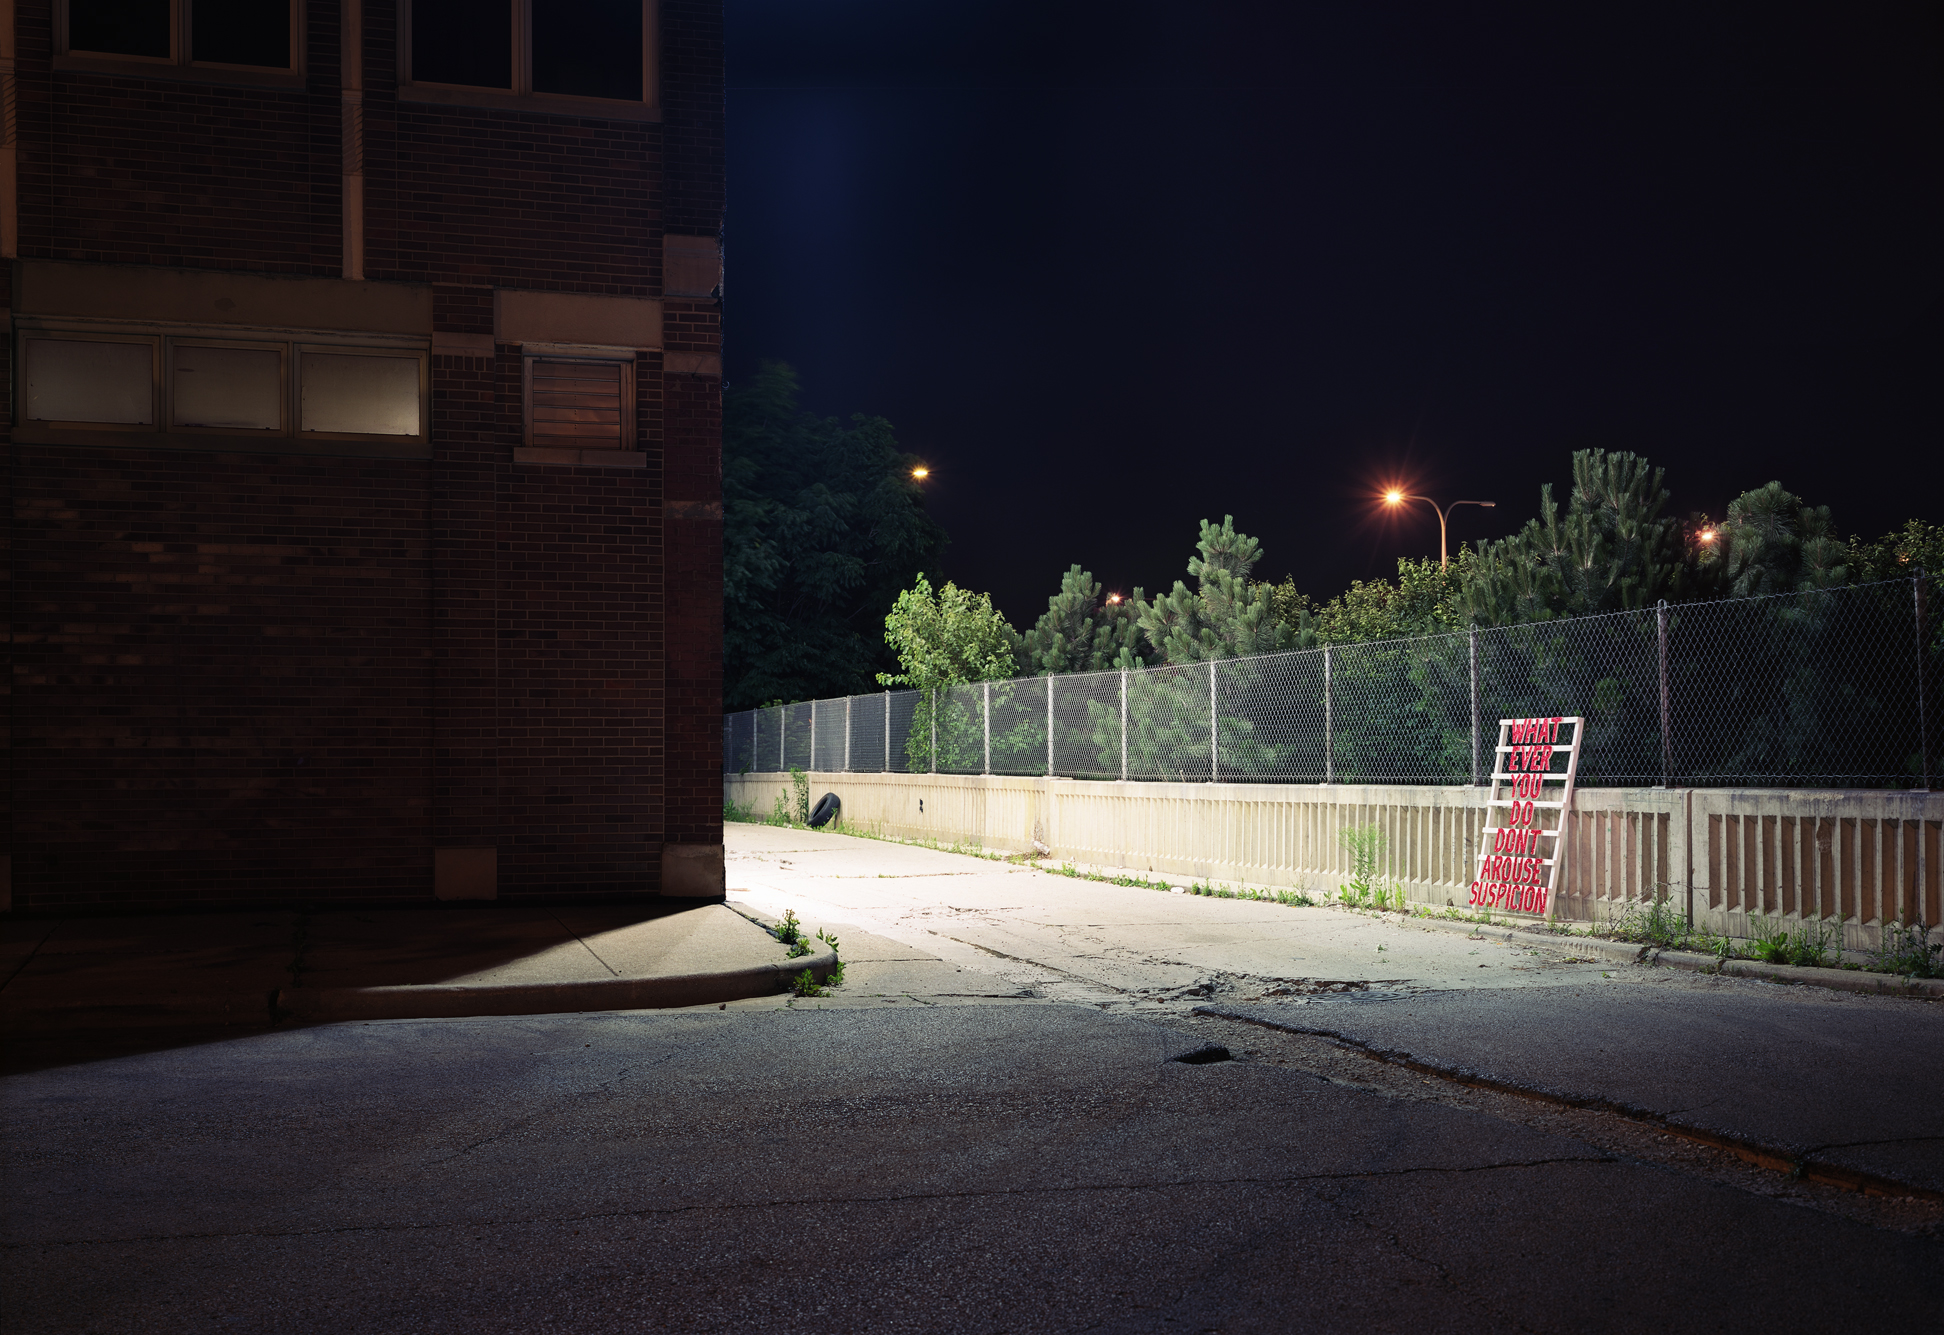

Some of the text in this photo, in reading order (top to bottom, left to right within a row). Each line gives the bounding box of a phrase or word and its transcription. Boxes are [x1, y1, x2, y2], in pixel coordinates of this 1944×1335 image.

[1511, 717, 1563, 743] WHAT
[1508, 745, 1553, 771] EVER
[1511, 773, 1543, 799] YOU
[1509, 800, 1534, 826] DO
[1480, 855, 1543, 885] AROUSE
[1468, 881, 1548, 914] SUSPICION
